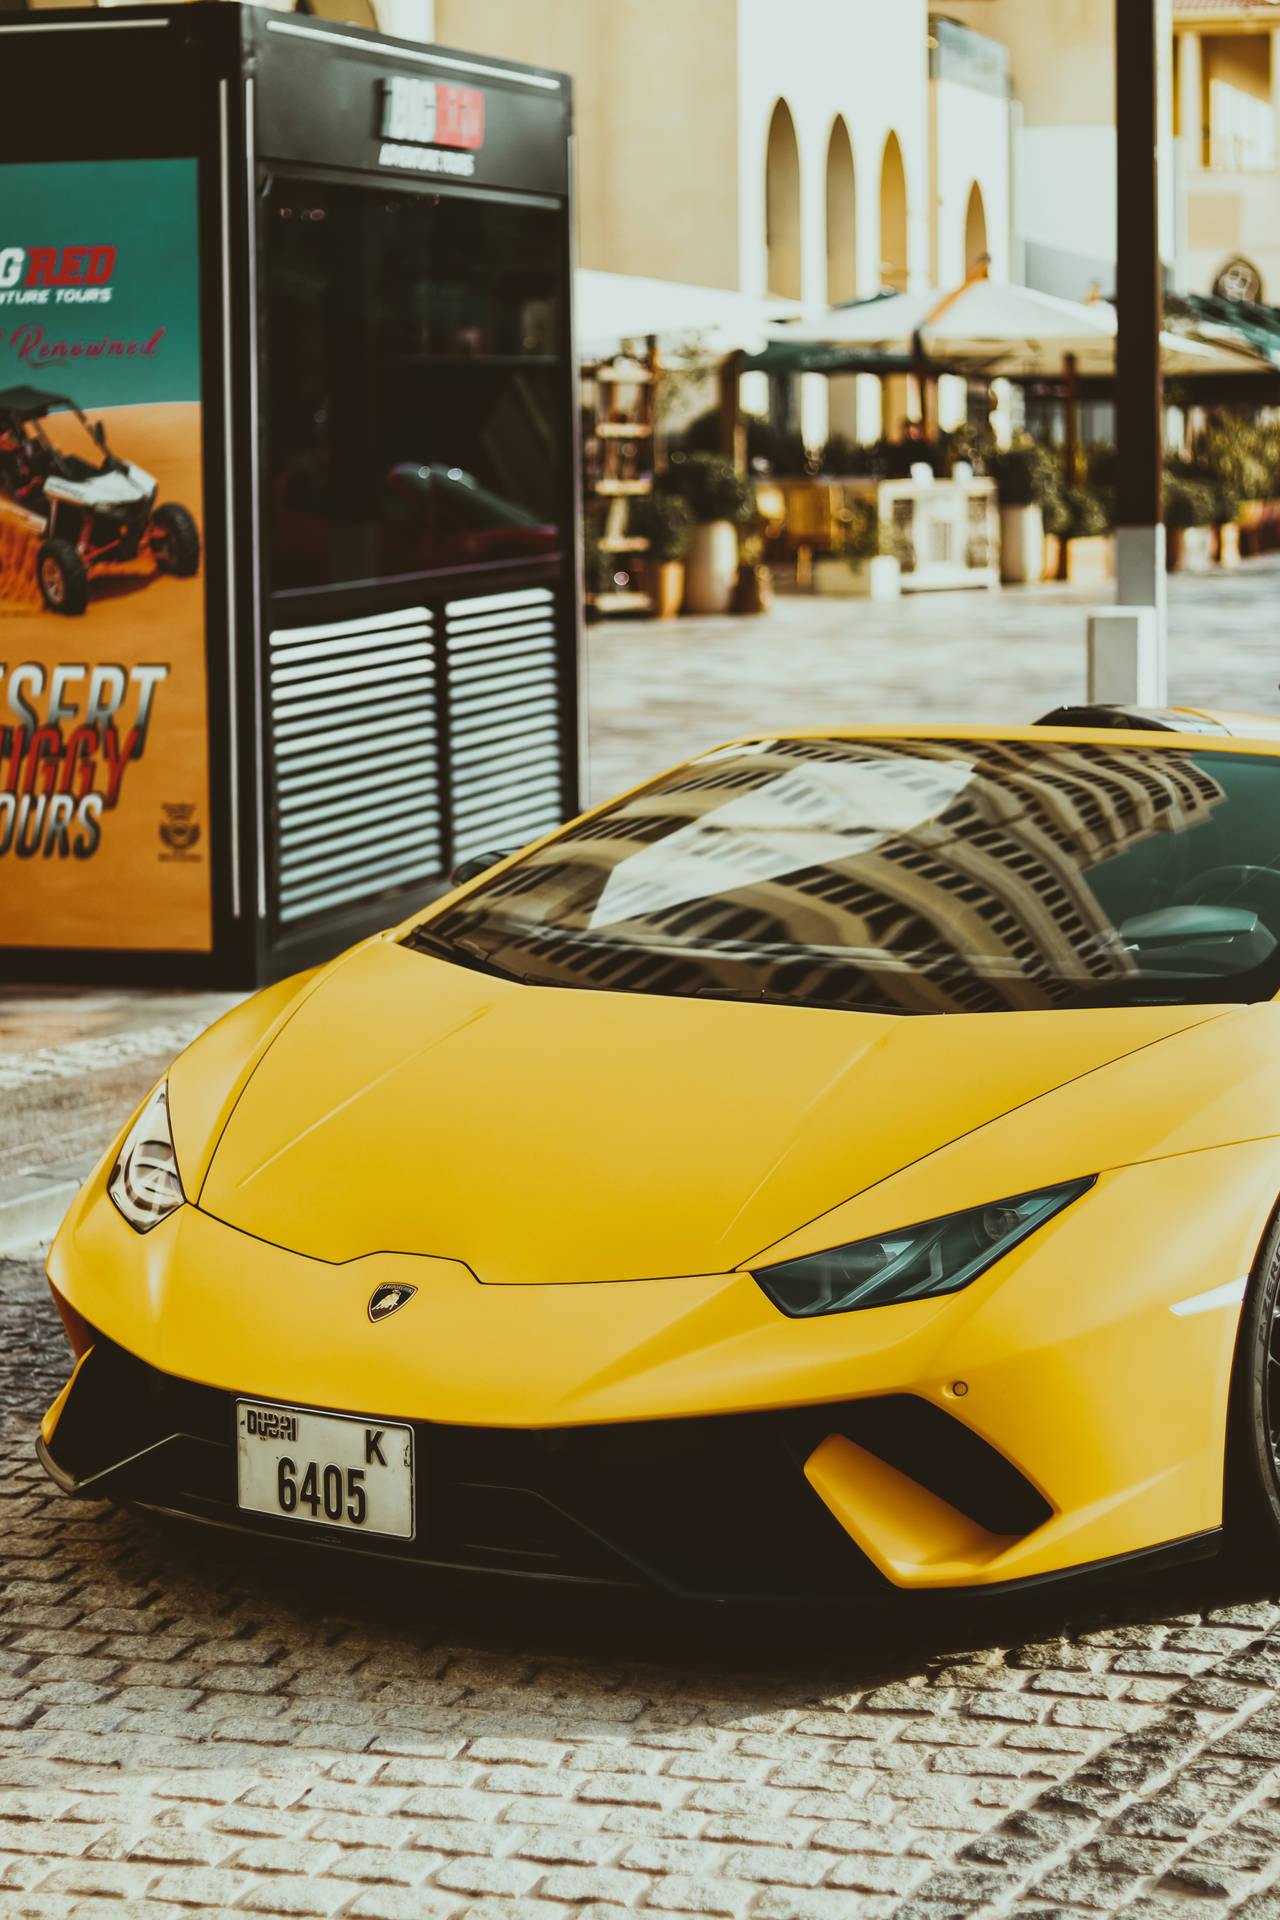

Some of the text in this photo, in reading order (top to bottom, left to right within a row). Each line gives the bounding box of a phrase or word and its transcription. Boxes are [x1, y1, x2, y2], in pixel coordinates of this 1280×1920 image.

[55, 287, 113, 304] TOURS
[9, 323, 166, 369] Renowned
[0, 661, 169, 760] SERT
[364, 1429, 388, 1467] K
[277, 1455, 367, 1525] 6405
